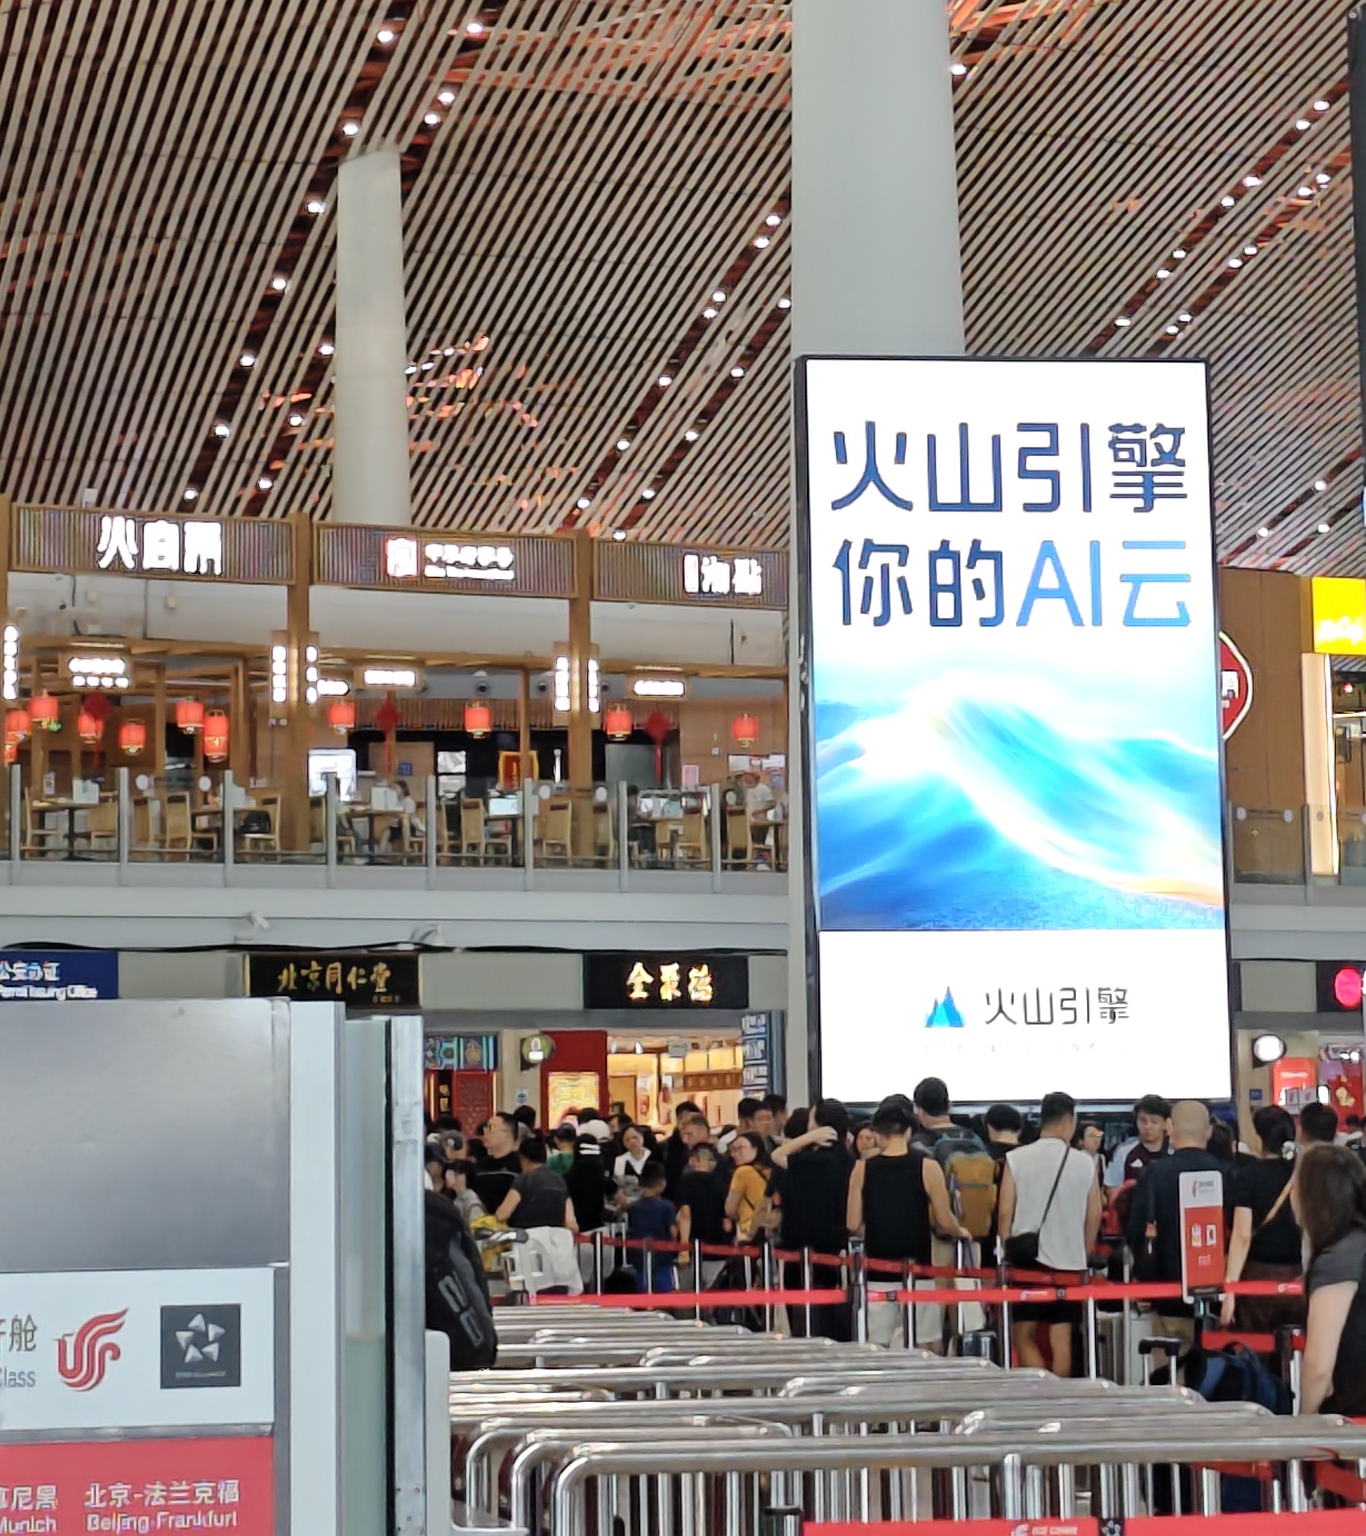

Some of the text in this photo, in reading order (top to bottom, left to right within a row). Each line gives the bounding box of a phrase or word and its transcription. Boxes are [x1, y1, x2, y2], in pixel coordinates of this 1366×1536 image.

[830, 420, 1188, 513] 火山引擎
[831, 537, 1192, 627] 你的AI云
[984, 986, 1131, 1025] 火山引擎
[84, 1479, 240, 1508] 北京-法兰克福
